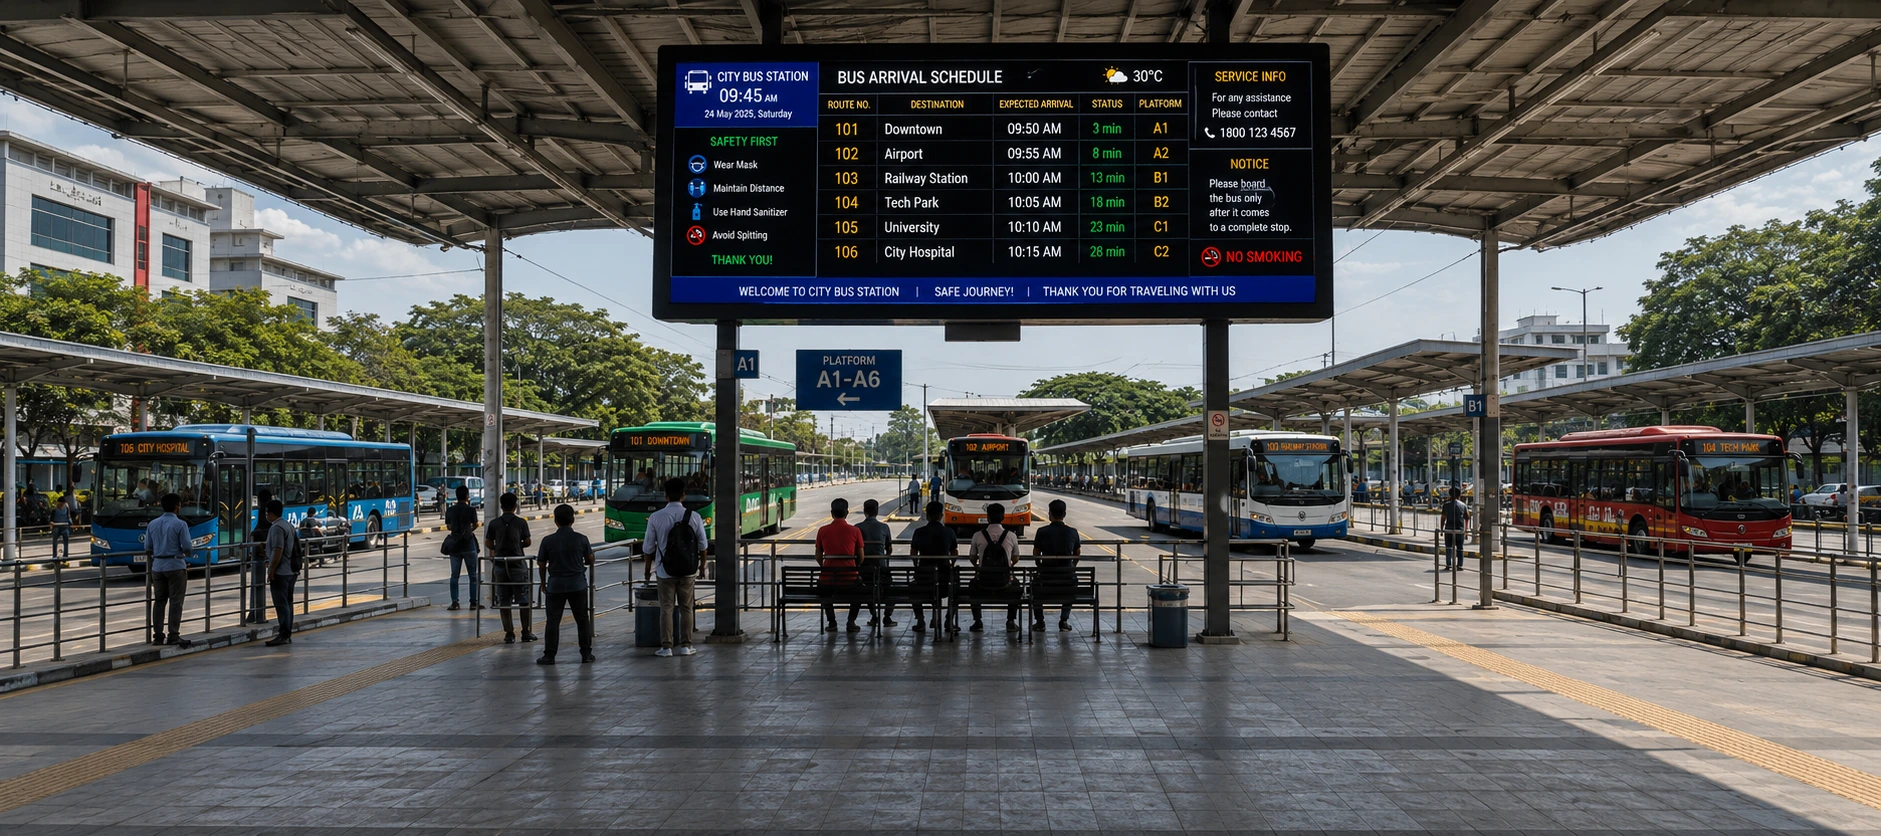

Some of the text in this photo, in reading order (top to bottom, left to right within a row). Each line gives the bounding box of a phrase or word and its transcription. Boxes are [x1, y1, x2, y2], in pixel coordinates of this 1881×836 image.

[718, 71, 808, 82] CITY BUS STATION
[838, 70, 1002, 84] BUS ARRIVAL SCHEDULE
[1133, 70, 1162, 82] 30°C
[1215, 71, 1286, 82] SERVICE INFO
[720, 88, 777, 102] 09:45 AM
[1212, 93, 1291, 104] For any assistance
[828, 100, 870, 109] ROUTE NO.
[911, 100, 964, 109] DESTINATION
[1000, 100, 1073, 108] EXPECTED ARRIVAL
[1092, 99, 1122, 108] STATUS
[1139, 99, 1182, 108] PLATFORM
[705, 109, 792, 119] 24 May 2025, Saturday
[1213, 108, 1277, 118] Please contact
[836, 123, 857, 135] 101
[885, 123, 942, 134] Downtown
[1008, 123, 1061, 134] 09:50 AM
[1093, 123, 1121, 134] 3 min
[1154, 122, 1167, 133] A1
[1221, 127, 1296, 138] 1800 123 4567
[711, 136, 778, 146] SAFETY FIRST
[836, 147, 858, 160] 102
[885, 148, 922, 162] Airport
[1008, 147, 1061, 159] 09:55 AM
[1093, 147, 1122, 158] 8 min
[1154, 147, 1169, 158] A2
[714, 160, 757, 169] Wear Mask
[1231, 159, 1268, 169] NOTICE
[836, 172, 858, 184] 103
[885, 173, 967, 186] Railway Station
[1009, 172, 1061, 183] 10:00 AM
[1091, 172, 1125, 183] 13 min
[1154, 172, 1167, 183] B1
[714, 184, 784, 192] Maintain Distance
[1210, 179, 1266, 188] Please board
[836, 196, 858, 208] 104
[885, 196, 938, 208] Tech Park
[1009, 196, 1061, 207] 10:05 AM
[1091, 196, 1124, 207] 18 min
[1154, 196, 1169, 207] B2
[1210, 193, 1262, 204] the bus only
[713, 208, 788, 216] Use Hand Sanitizer
[1210, 208, 1230, 216] after
[1233, 208, 1238, 216] it
[835, 221, 858, 233] 105
[885, 222, 939, 235] University
[1009, 221, 1061, 232] 10:10 AM
[1090, 221, 1124, 232] 23 min
[1154, 221, 1167, 232] C1
[1228, 223, 1268, 233] complete
[1271, 223, 1291, 233] stop.
[713, 231, 767, 241] Avoid Spitting
[835, 246, 858, 258] 106
[885, 246, 954, 260] City Hospital
[1009, 246, 1061, 257] 10:15 AM
[1090, 246, 1125, 257] 28 min
[1154, 246, 1169, 257] C2
[1227, 251, 1302, 262] NO SMOKING
[712, 255, 772, 265] THANK YOU!
[739, 286, 899, 296] WELCOME TO CITY BUS STATION
[935, 287, 1013, 297] SAFE JOURNEY!
[1043, 286, 1235, 296] THANK YOU FOR TRAVELING WITH US
[738, 357, 753, 371] A1
[823, 356, 875, 365] PLATFORM
[817, 370, 880, 387] A1-A6
[1469, 400, 1481, 412] B1
[630, 435, 690, 446] 101 DOWNTOWN
[120, 442, 189, 454] 106 CITY HOSPITAL
[965, 443, 1010, 451] 102 AIRPORT
